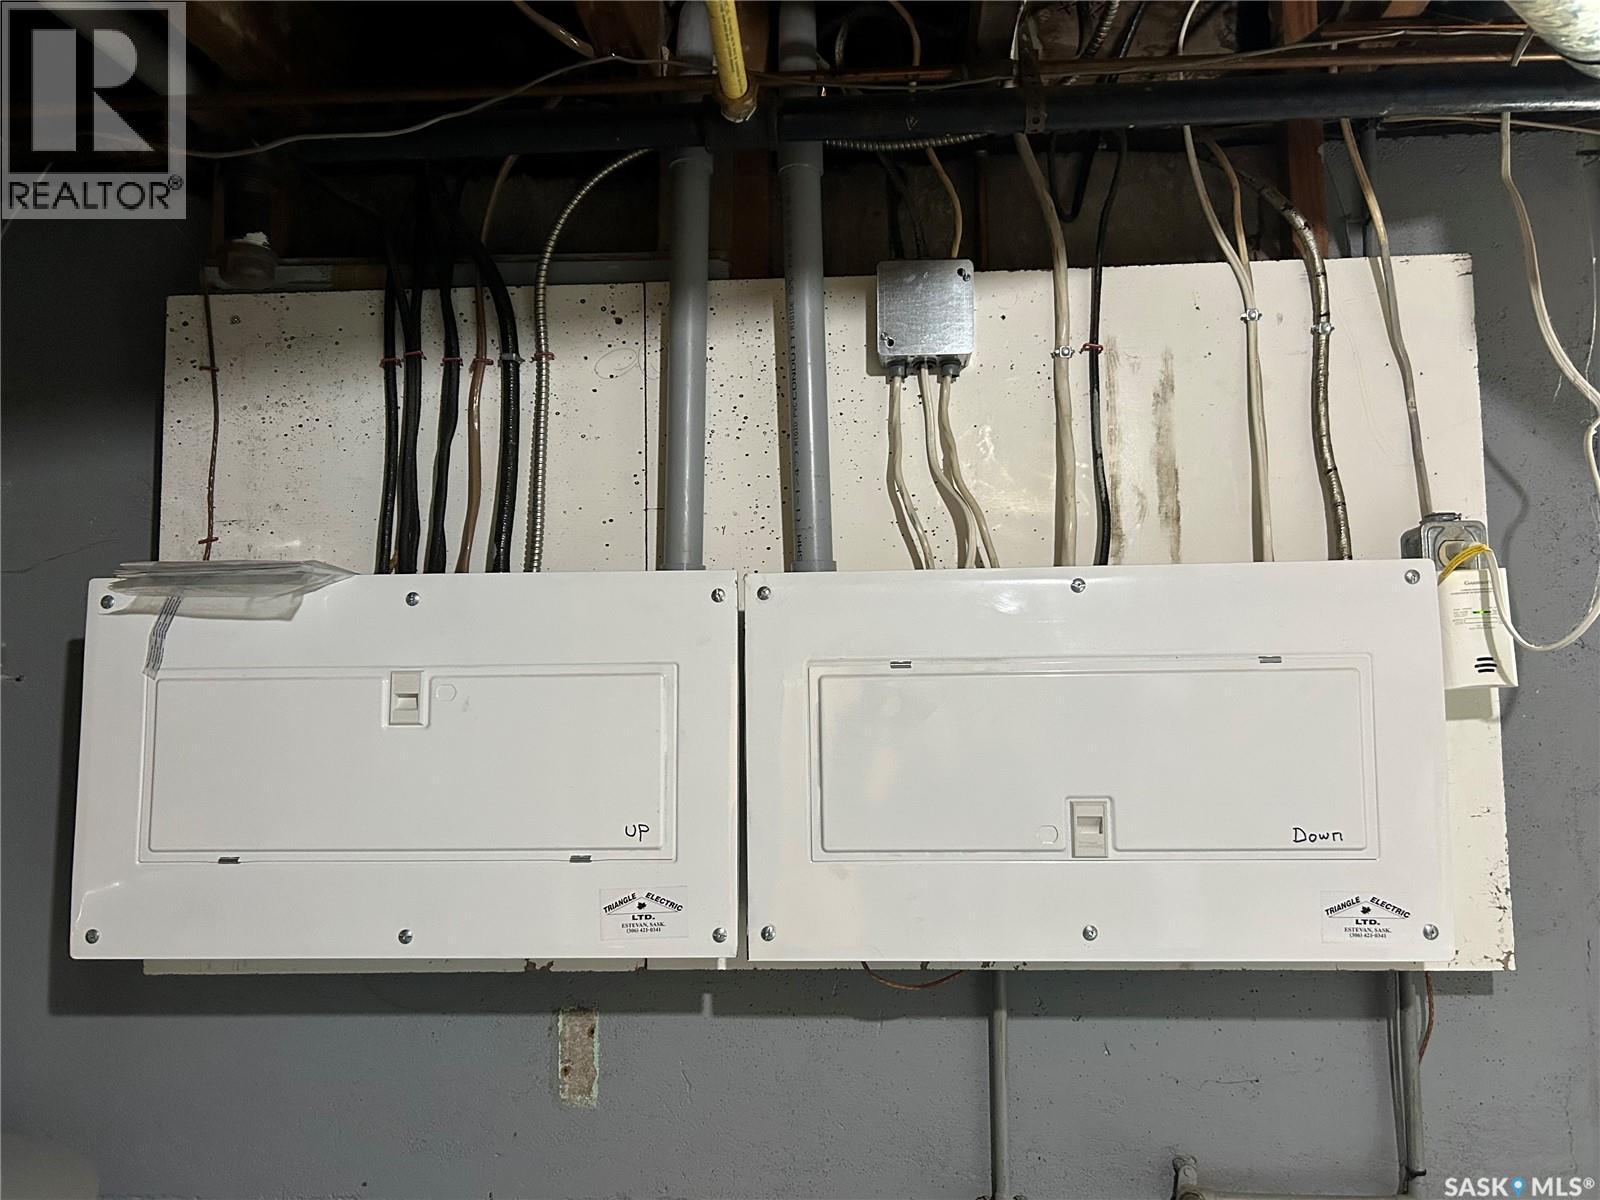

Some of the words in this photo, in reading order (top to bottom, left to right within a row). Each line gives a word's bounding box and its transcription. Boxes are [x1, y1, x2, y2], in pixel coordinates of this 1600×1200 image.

[624, 823, 650, 842] UP
[1292, 827, 1344, 843] Down
[603, 892, 637, 914] TRIANGLE
[645, 892, 684, 912] ELECTRIC
[1325, 896, 1361, 916] TRIANGLE
[1369, 896, 1411, 919] ELECTRIC
